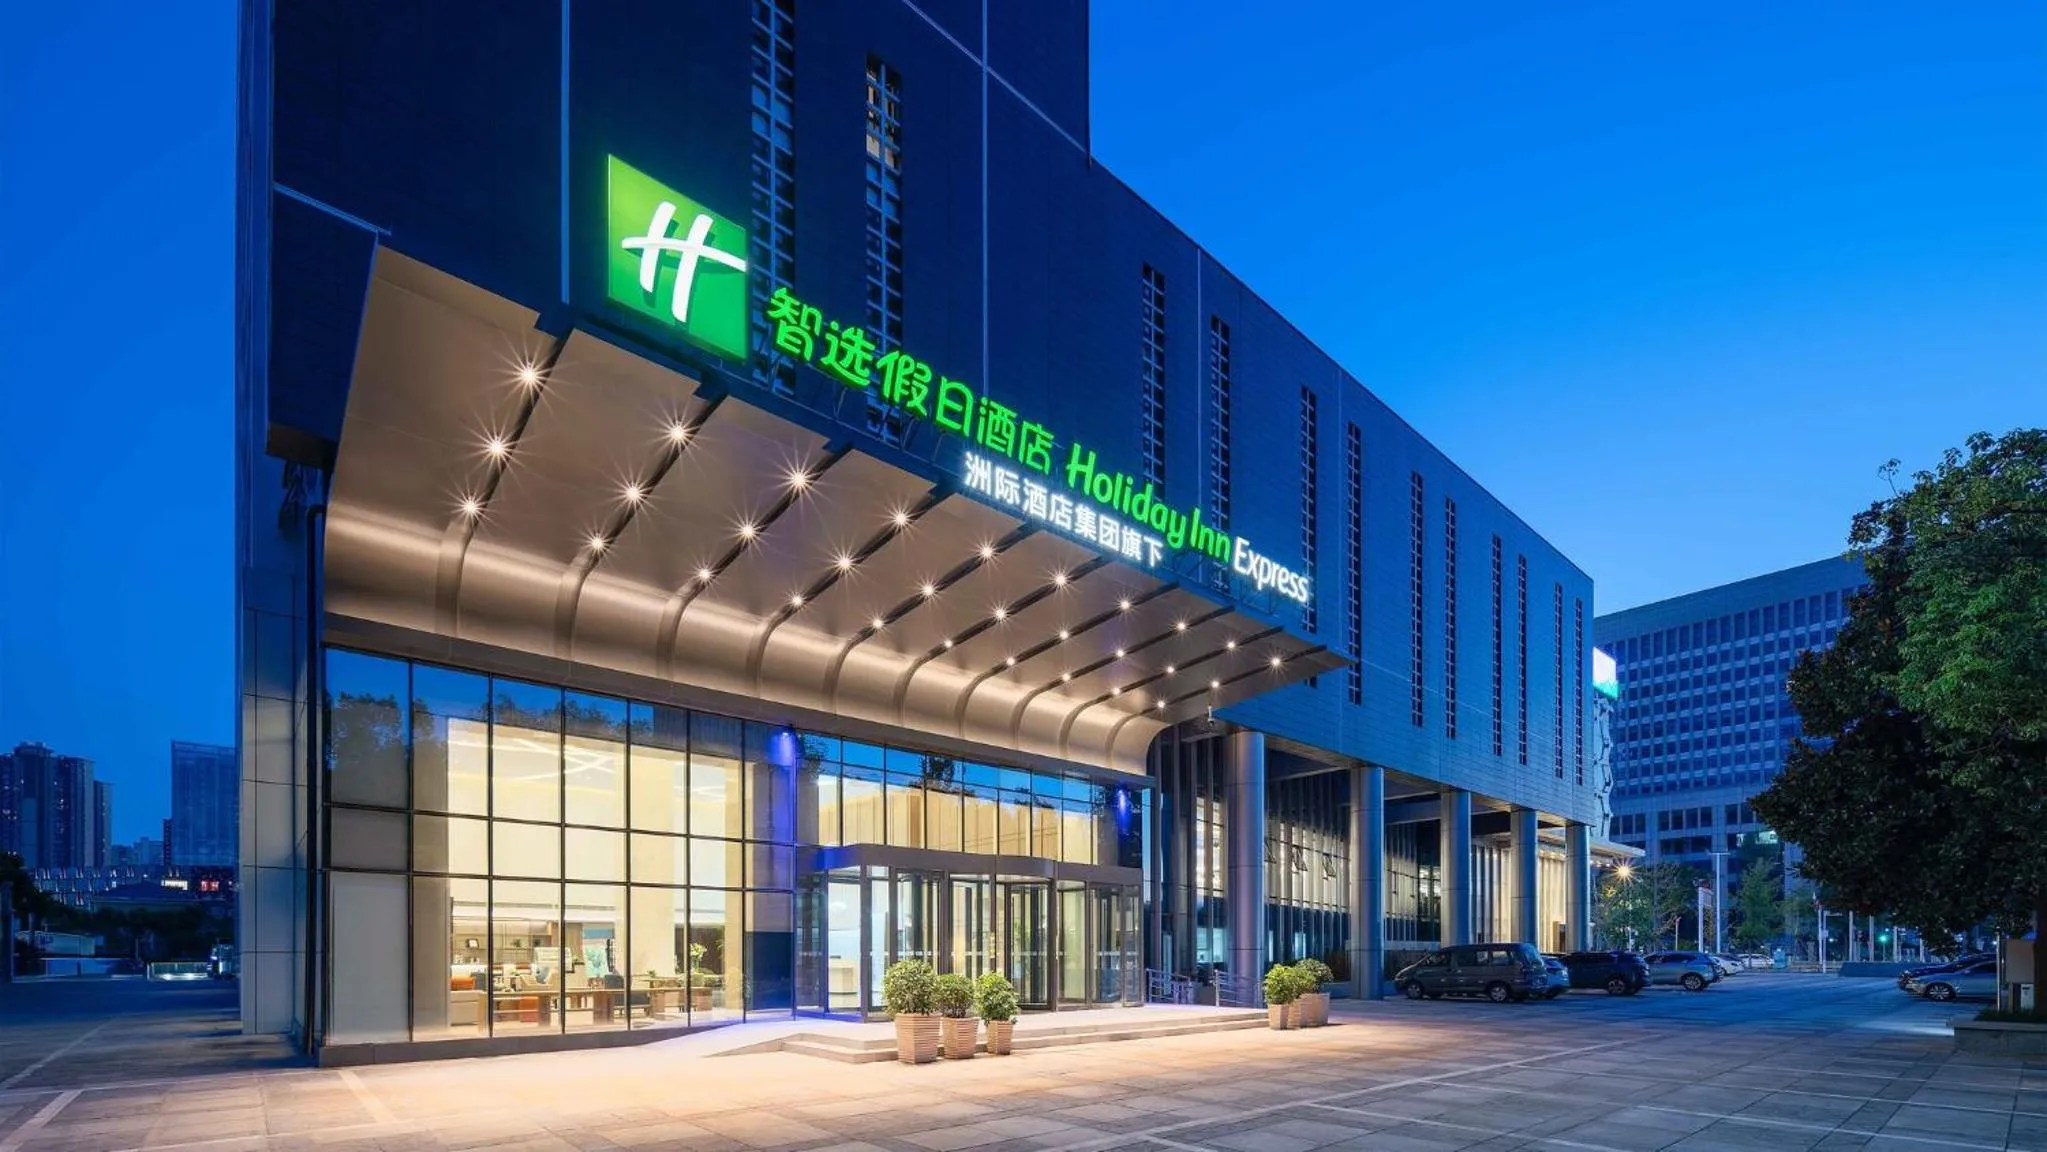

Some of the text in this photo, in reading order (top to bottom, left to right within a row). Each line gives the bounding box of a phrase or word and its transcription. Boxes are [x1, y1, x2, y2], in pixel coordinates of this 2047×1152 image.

[767, 287, 1055, 475] 智选假日酒店
[964, 451, 1164, 567] 洲际酒店集团旗下
[1066, 443, 1310, 603] Holiday Inn Express
